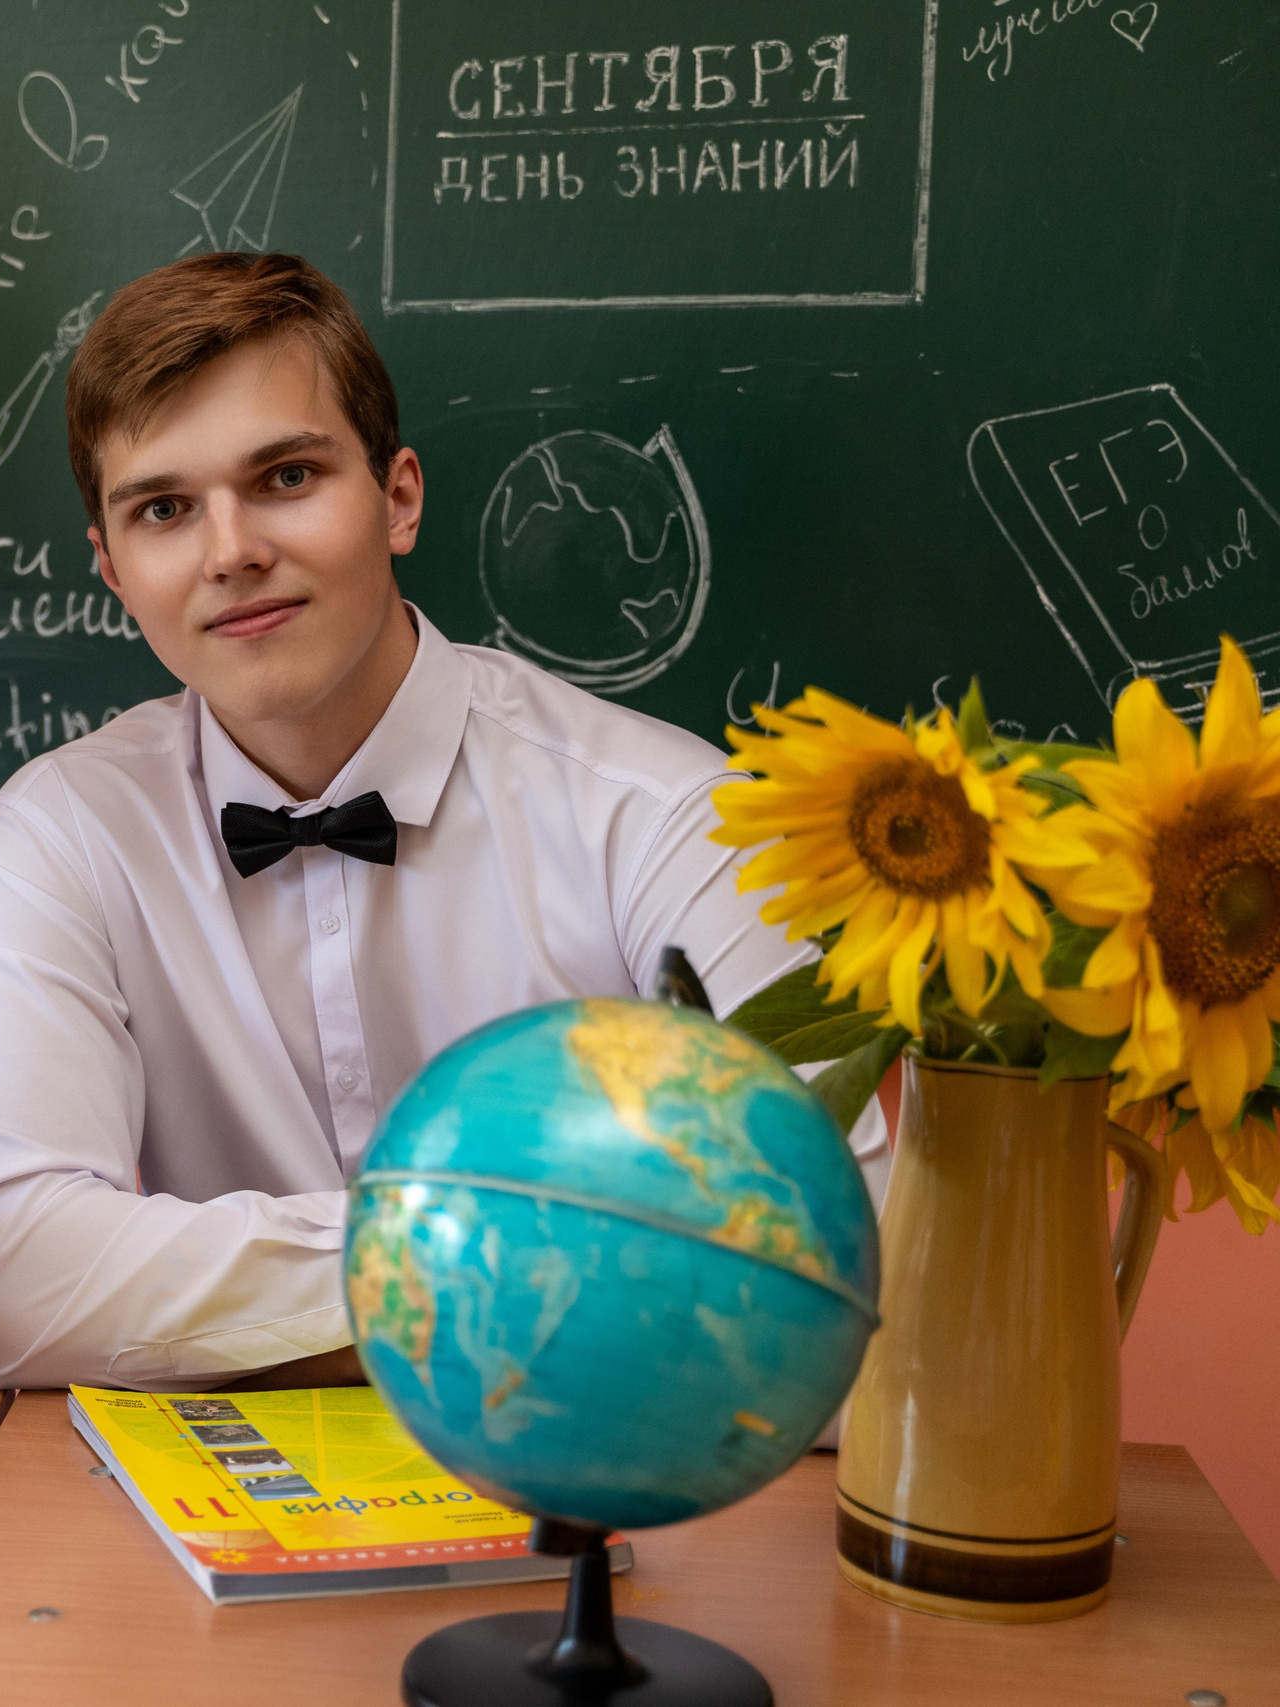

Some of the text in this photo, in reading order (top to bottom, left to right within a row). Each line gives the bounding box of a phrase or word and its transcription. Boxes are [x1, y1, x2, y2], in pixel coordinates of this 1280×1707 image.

[448, 33, 852, 120] СЕНТЯБРЯ
[433, 121, 860, 204] ДЕНЬ ЗНАНИЙ
[1048, 418, 1189, 528] ЕГЭ
[1117, 507, 1260, 620] баллов
[173, 1496, 239, 1519] 11
